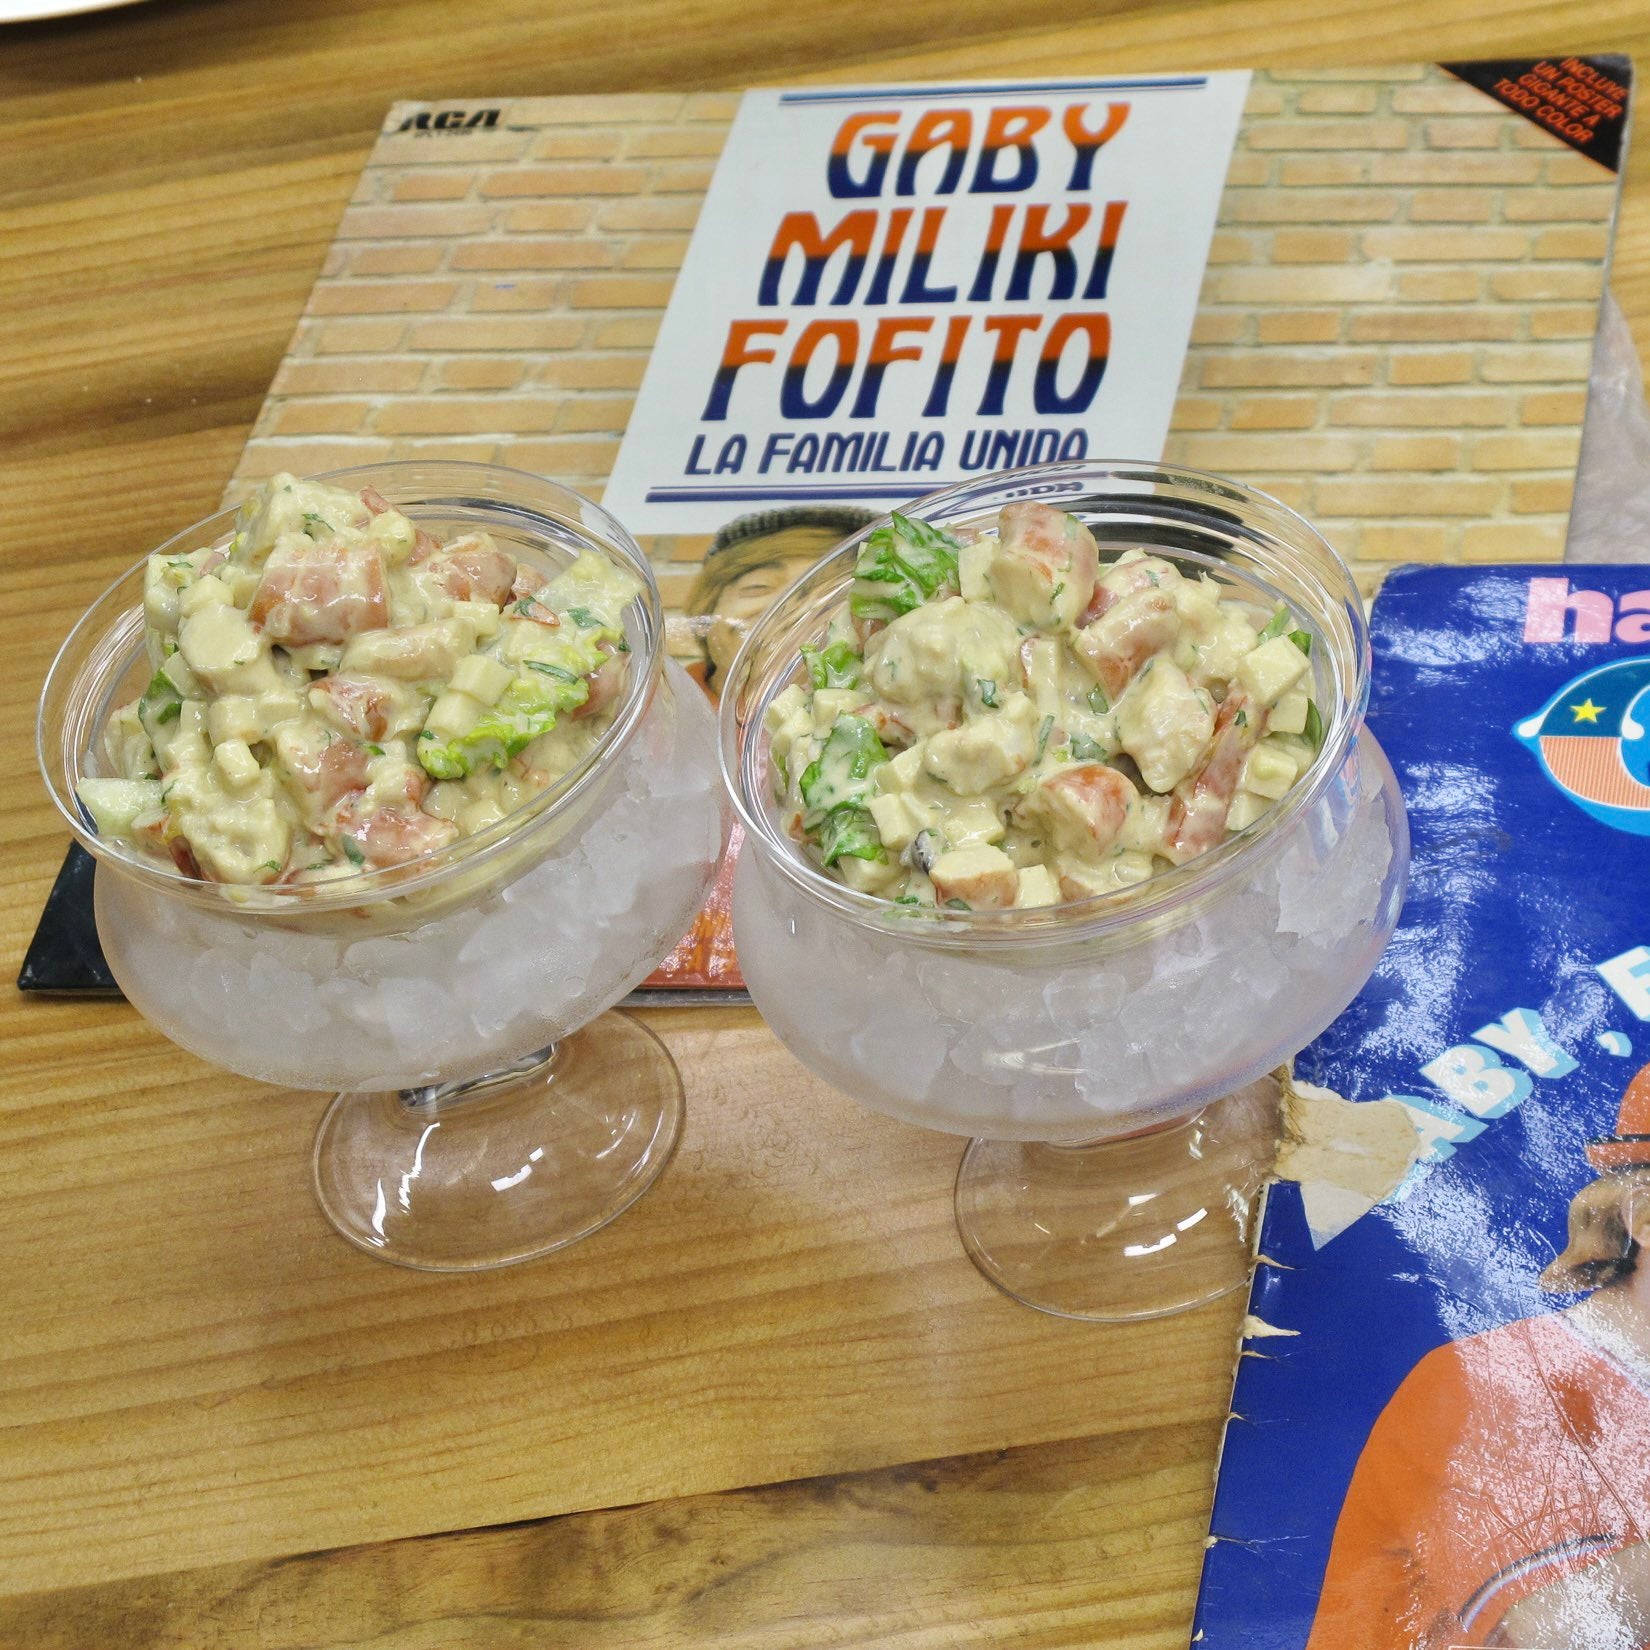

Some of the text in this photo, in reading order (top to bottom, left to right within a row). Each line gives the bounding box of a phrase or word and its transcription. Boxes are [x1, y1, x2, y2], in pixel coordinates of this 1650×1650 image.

[1519, 74, 1600, 128] GIGANTE A
[1533, 61, 1623, 118] UN POSTER
[1560, 57, 1628, 100] INCLUYE
[398, 109, 501, 132] RCA
[1494, 78, 1594, 143] TODO COLOR
[826, 102, 1130, 198] GABY
[758, 201, 1128, 306] MILIKI
[700, 312, 1111, 421] FOFITO
[685, 427, 1088, 475] LA FAMILIA UNIDA
